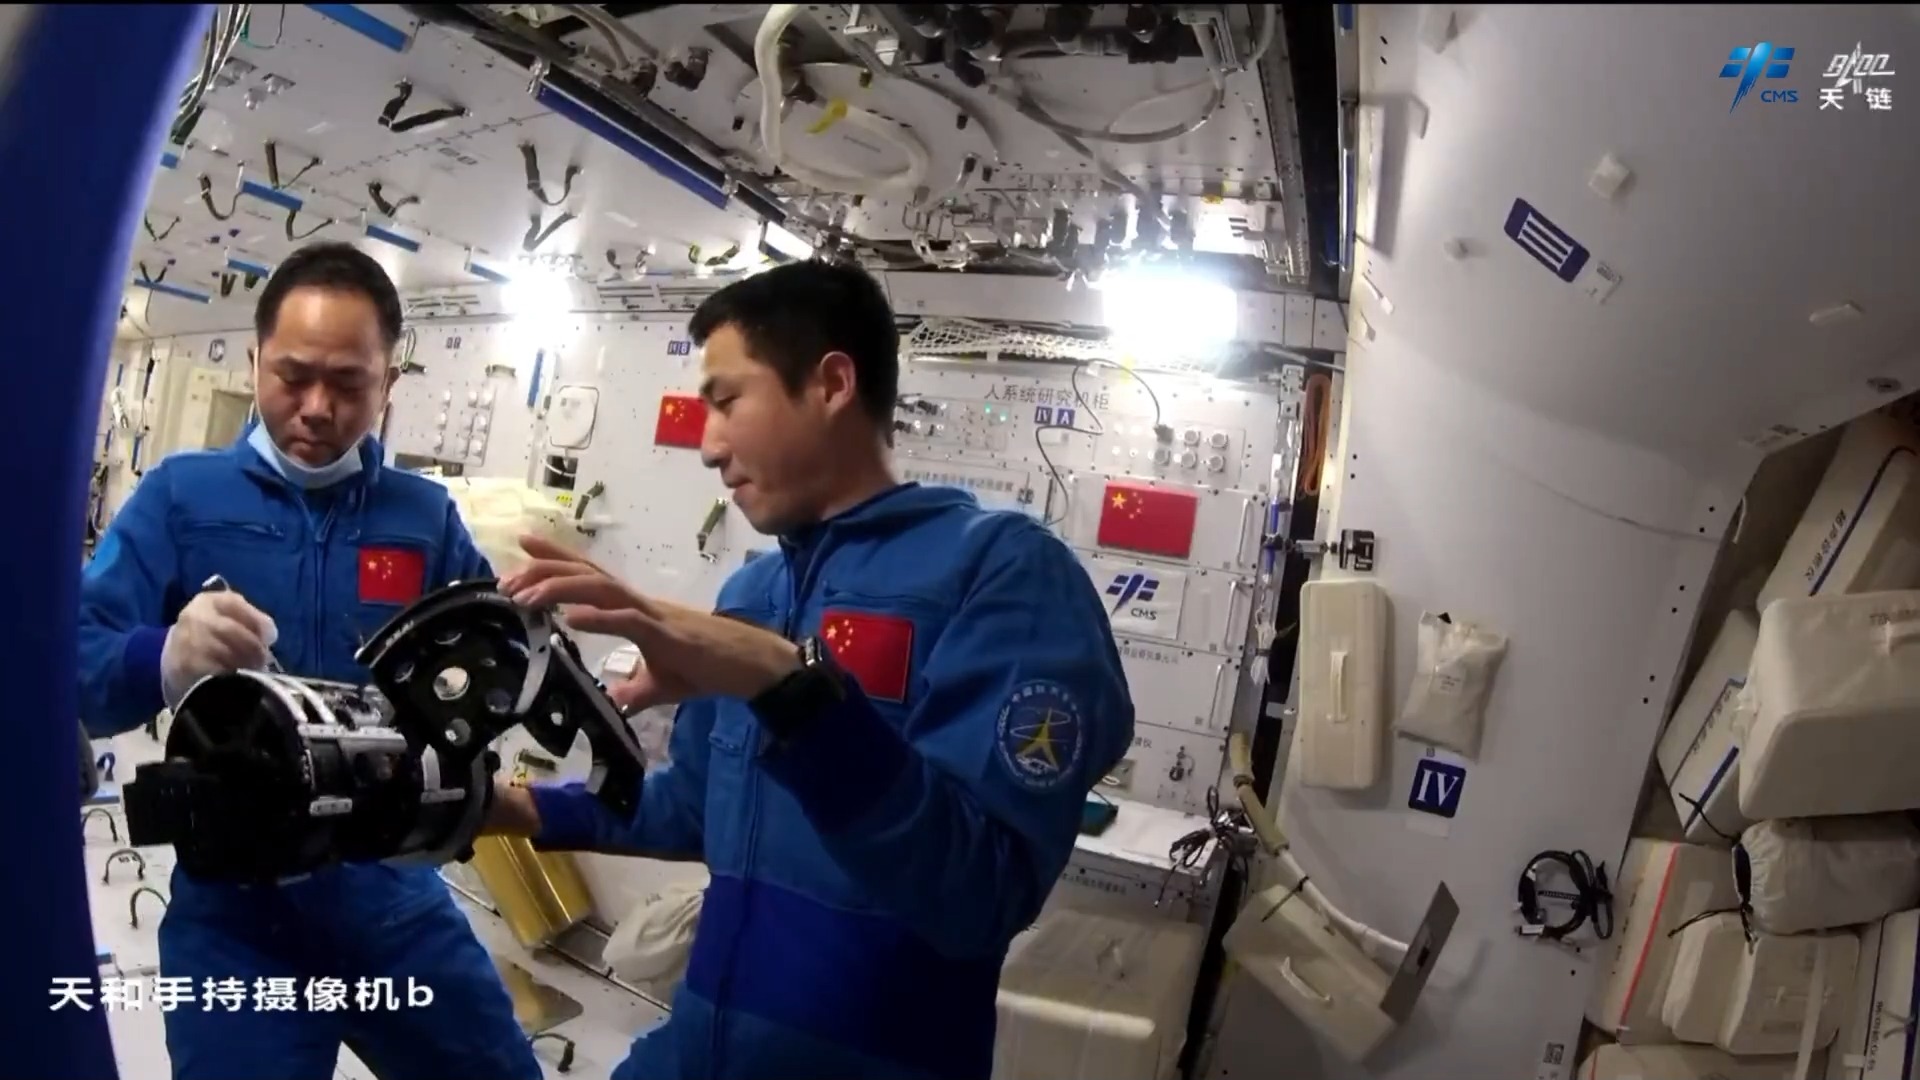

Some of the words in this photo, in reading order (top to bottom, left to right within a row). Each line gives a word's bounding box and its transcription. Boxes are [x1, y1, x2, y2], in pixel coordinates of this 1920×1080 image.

[984, 384, 1110, 410] 人系统研究机柜
[1131, 607, 1157, 620] CMS
[1416, 768, 1460, 806] IV
